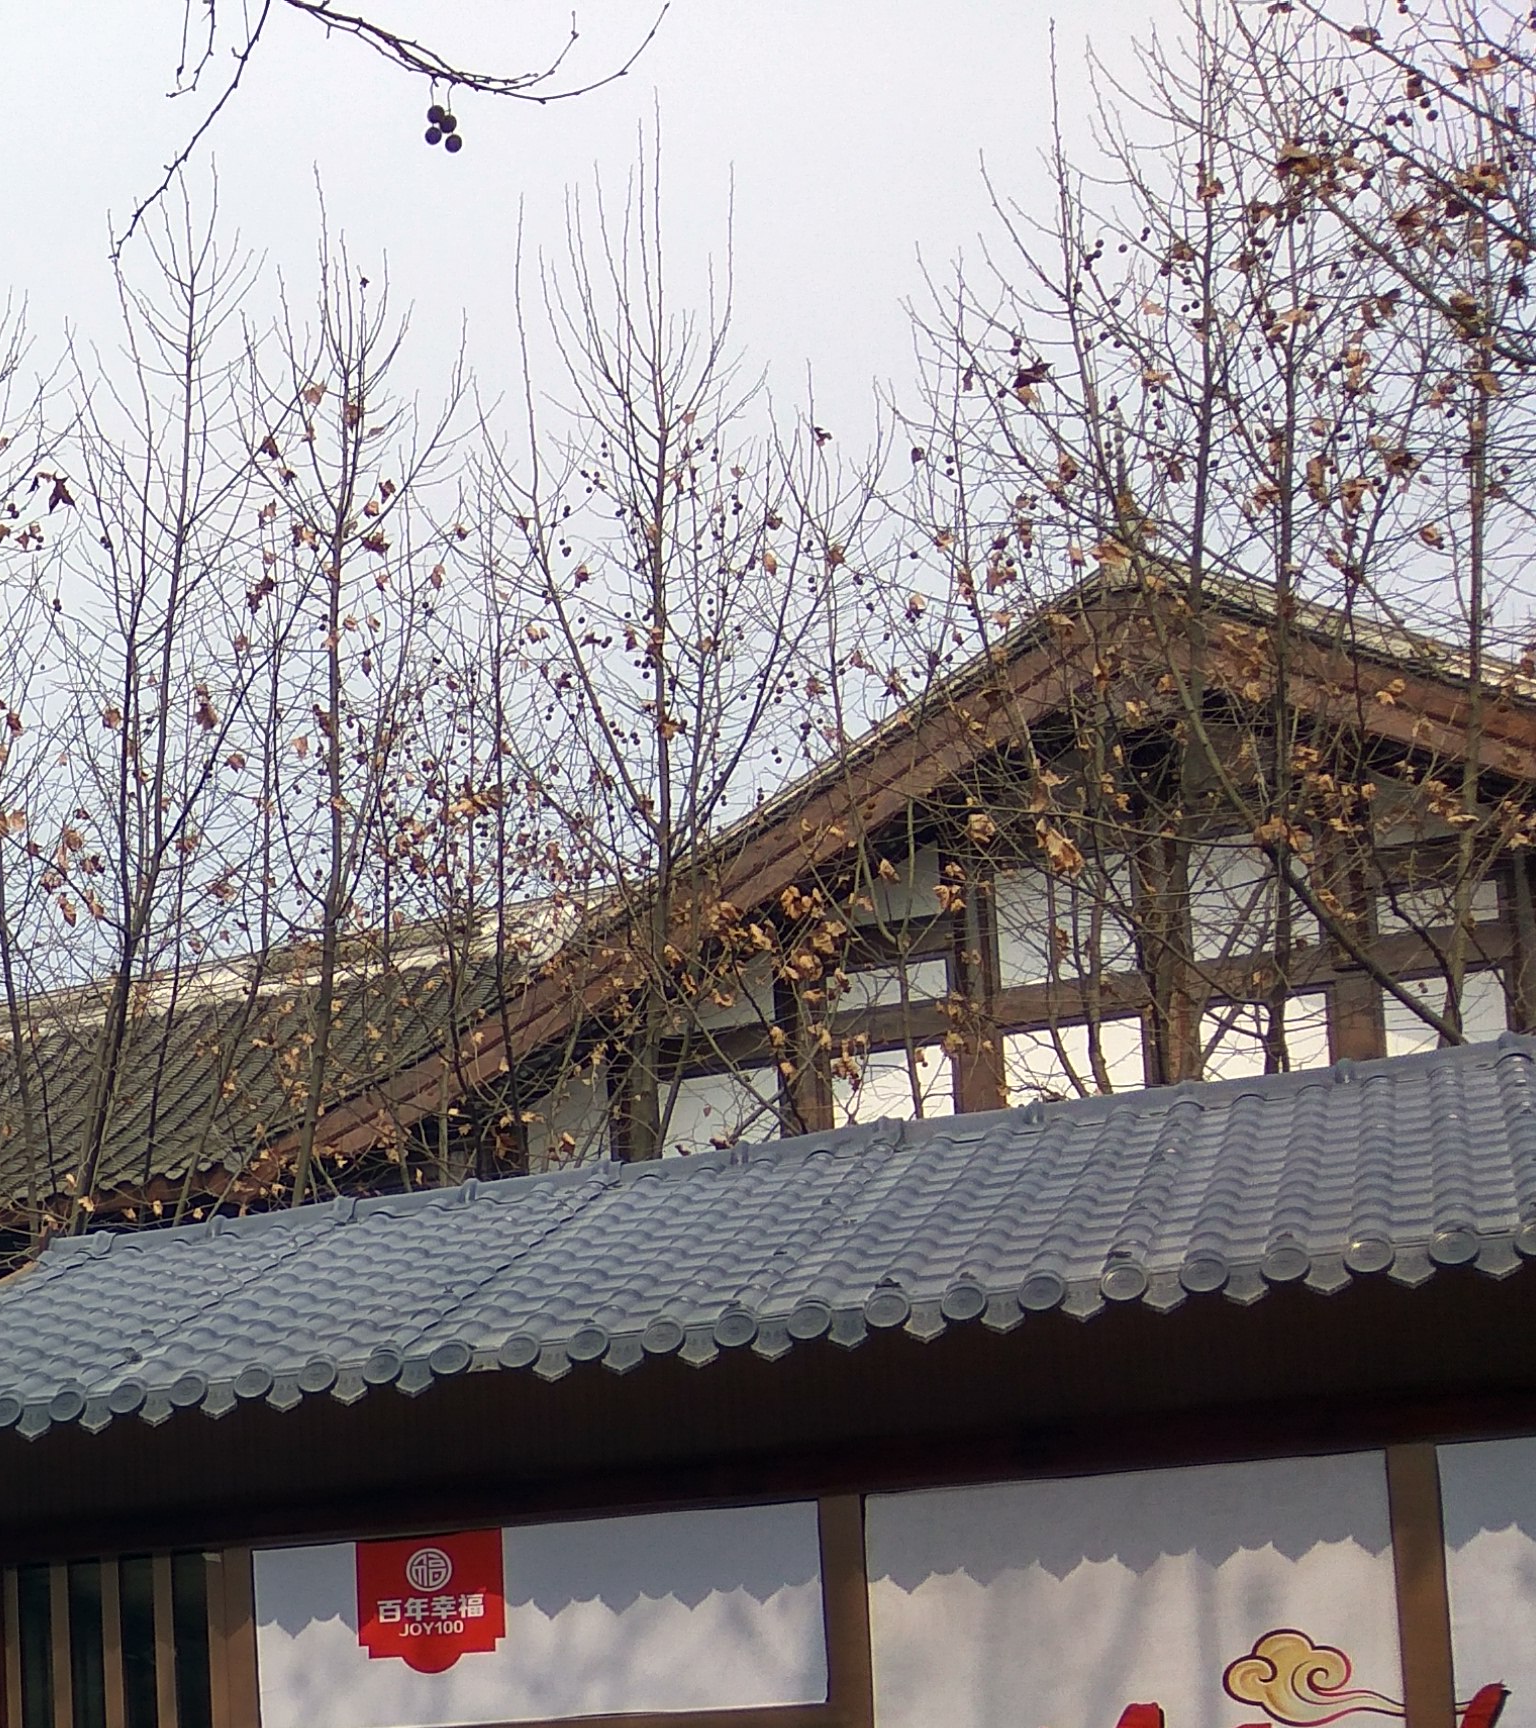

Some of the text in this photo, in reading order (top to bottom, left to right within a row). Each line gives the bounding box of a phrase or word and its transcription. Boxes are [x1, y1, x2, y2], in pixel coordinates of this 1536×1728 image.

[377, 1593, 484, 1623] 百年幸福
[399, 1620, 464, 1637] JOY100
